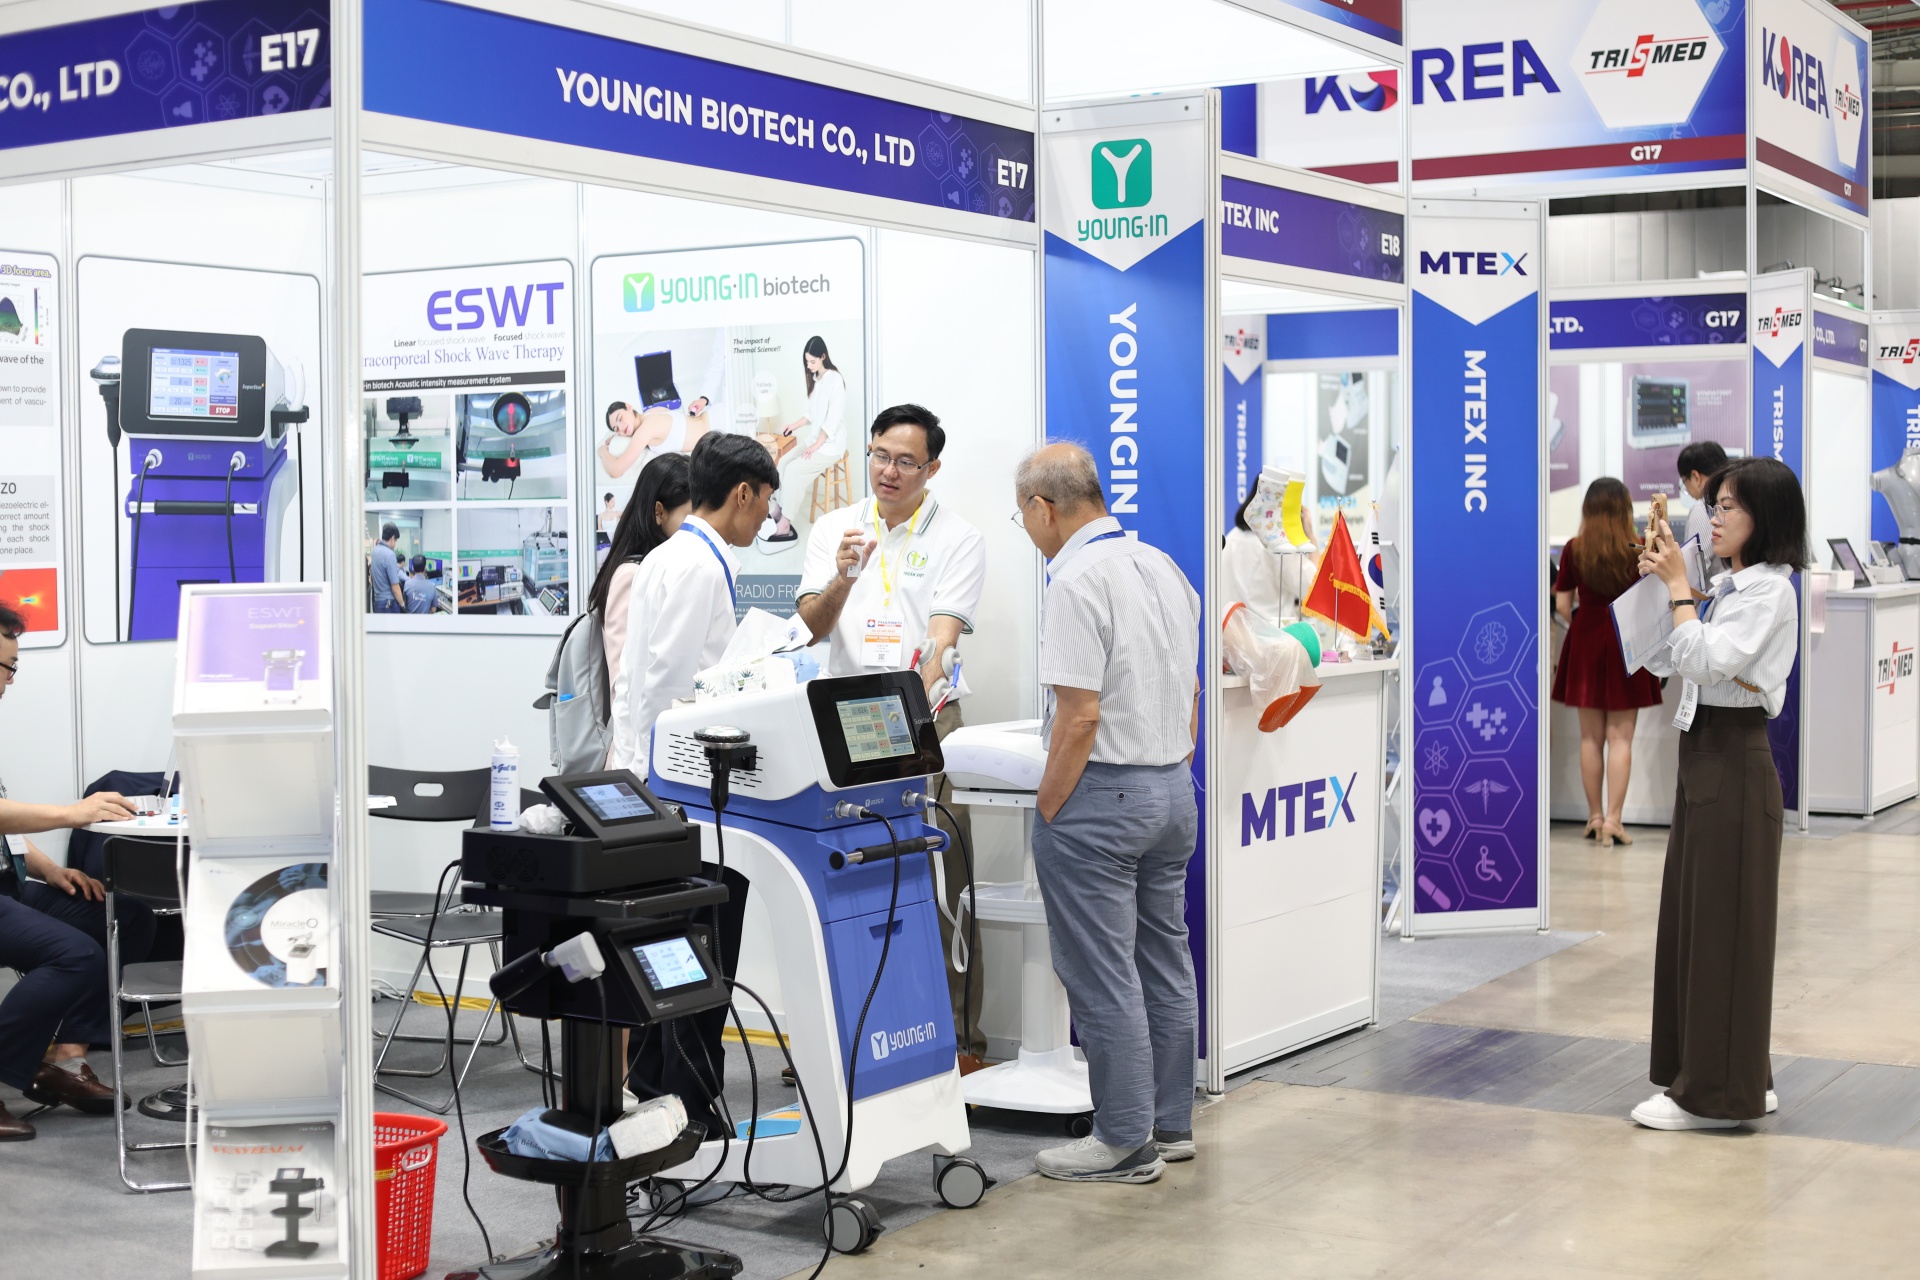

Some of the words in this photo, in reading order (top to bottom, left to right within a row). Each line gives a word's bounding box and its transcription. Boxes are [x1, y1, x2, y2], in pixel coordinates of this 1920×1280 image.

[261, 28, 319, 72] E17
[1590, 35, 1708, 77] TRISMED
[59, 59, 121, 102] LTD
[1835, 86, 1860, 119] TRISMED
[555, 67, 692, 126] YOUNGIN
[701, 97, 814, 149] BIOTECH
[821, 122, 868, 166] CO.,
[874, 132, 915, 167] LTD
[1630, 145, 1662, 162] G17
[997, 158, 1028, 190] E17
[1255, 208, 1279, 234] INC
[1381, 233, 1400, 257] E18
[1, 264, 12, 275] 3D
[13, 265, 33, 276] focus
[33, 268, 51, 279] area.
[1420, 251, 1528, 276] MTEX
[763, 274, 830, 296] biotech
[427, 282, 564, 331] ESWT
[1705, 310, 1740, 328] G17
[1758, 309, 1802, 334] TRISMED
[394, 339, 416, 348] Linear
[417, 337, 445, 346] focused
[494, 332, 523, 342] Focused
[744, 337, 763, 346] impact
[764, 336, 771, 345] of
[20, 355, 29, 364] of
[30, 355, 44, 364] the
[362, 349, 430, 370] racorporeal
[434, 347, 471, 363] Shock
[476, 346, 509, 361] Wave
[513, 344, 565, 362] Therapy
[733, 346, 757, 354] Thermal
[1880, 339, 1920, 363] TRIS
[13, 385, 20, 393] to
[22, 386, 46, 394] provide
[372, 381, 394, 390] biotech
[395, 379, 420, 389] Acoustic
[420, 378, 447, 389] intensity
[447, 377, 488, 387] measurement
[489, 375, 512, 386] system
[15, 397, 22, 405] of
[1109, 302, 1139, 514] YOUNGIN
[1464, 350, 1487, 445] MTEX
[1237, 399, 1248, 504] TRISMED
[0, 482, 17, 494] ZO
[1464, 454, 1488, 513] INC
[0, 501, 39, 509] ezoelectric
[7, 535, 24, 543] each
[29, 534, 50, 543] shock
[12, 524, 24, 532] the
[29, 523, 50, 532] shock
[14, 546, 35, 556] place.
[735, 584, 775, 599] RADIO
[248, 606, 304, 619] ESWT
[1878, 646, 1913, 689] TRISMED
[1241, 771, 1358, 847] MTEX
